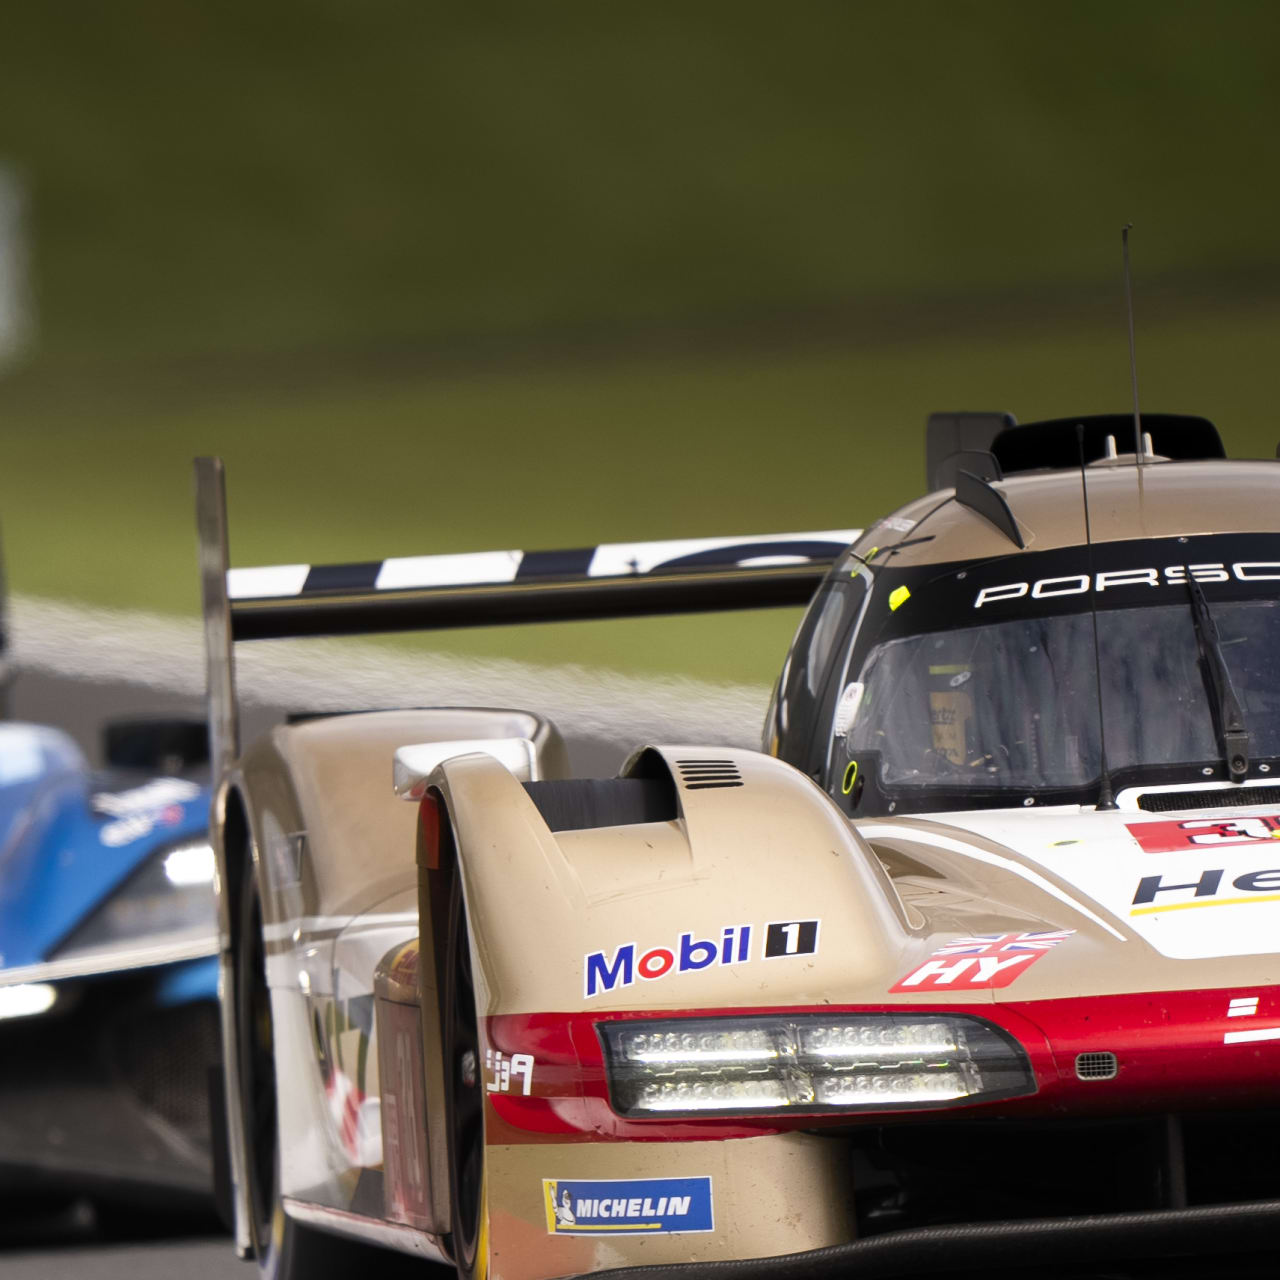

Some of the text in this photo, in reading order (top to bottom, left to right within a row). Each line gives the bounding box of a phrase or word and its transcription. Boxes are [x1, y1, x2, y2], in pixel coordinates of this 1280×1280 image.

[586, 925, 751, 998] Mobil
[901, 953, 1036, 987] HY
[576, 1196, 691, 1218] MICHELIN
